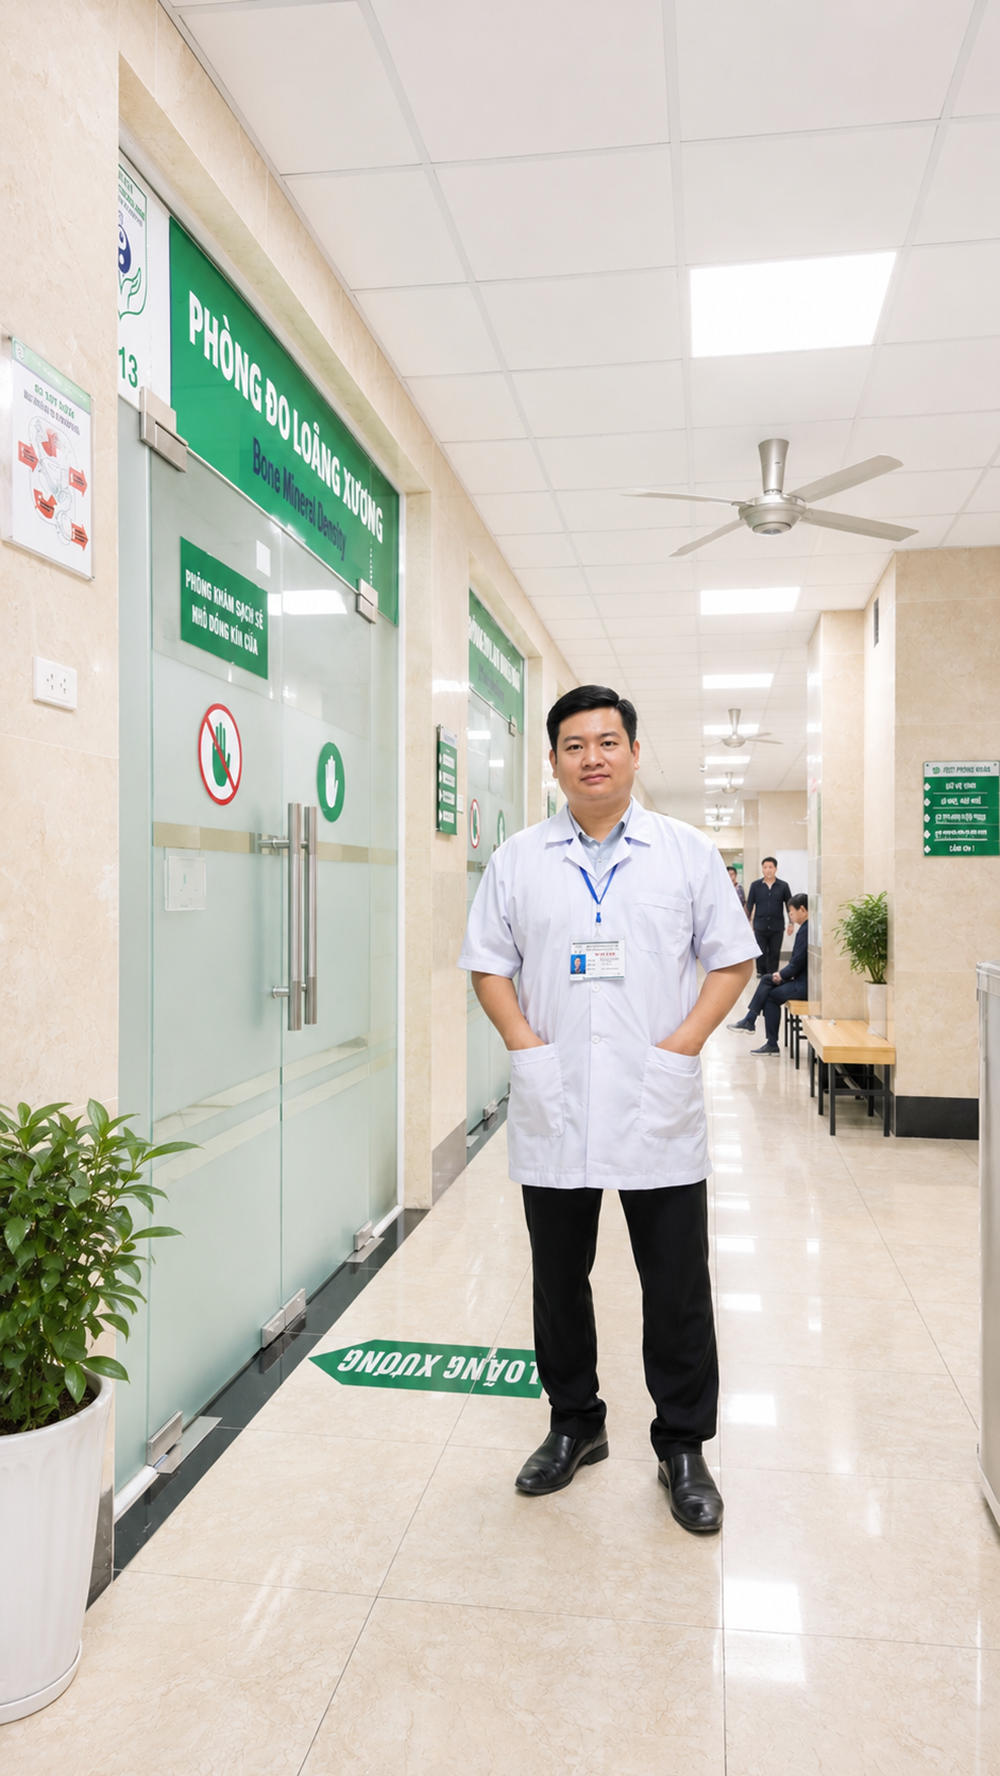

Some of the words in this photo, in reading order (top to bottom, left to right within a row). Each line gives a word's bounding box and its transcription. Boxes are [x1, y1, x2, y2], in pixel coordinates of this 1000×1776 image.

[188, 290, 263, 413] PHÒNG
[265, 378, 291, 441] ĐO
[342, 466, 383, 544] XƯƠNG
[253, 436, 281, 494] Bone
[283, 466, 316, 527] Mineral
[318, 501, 347, 562] Density
[337, 1349, 443, 1379] XƯƠNG
